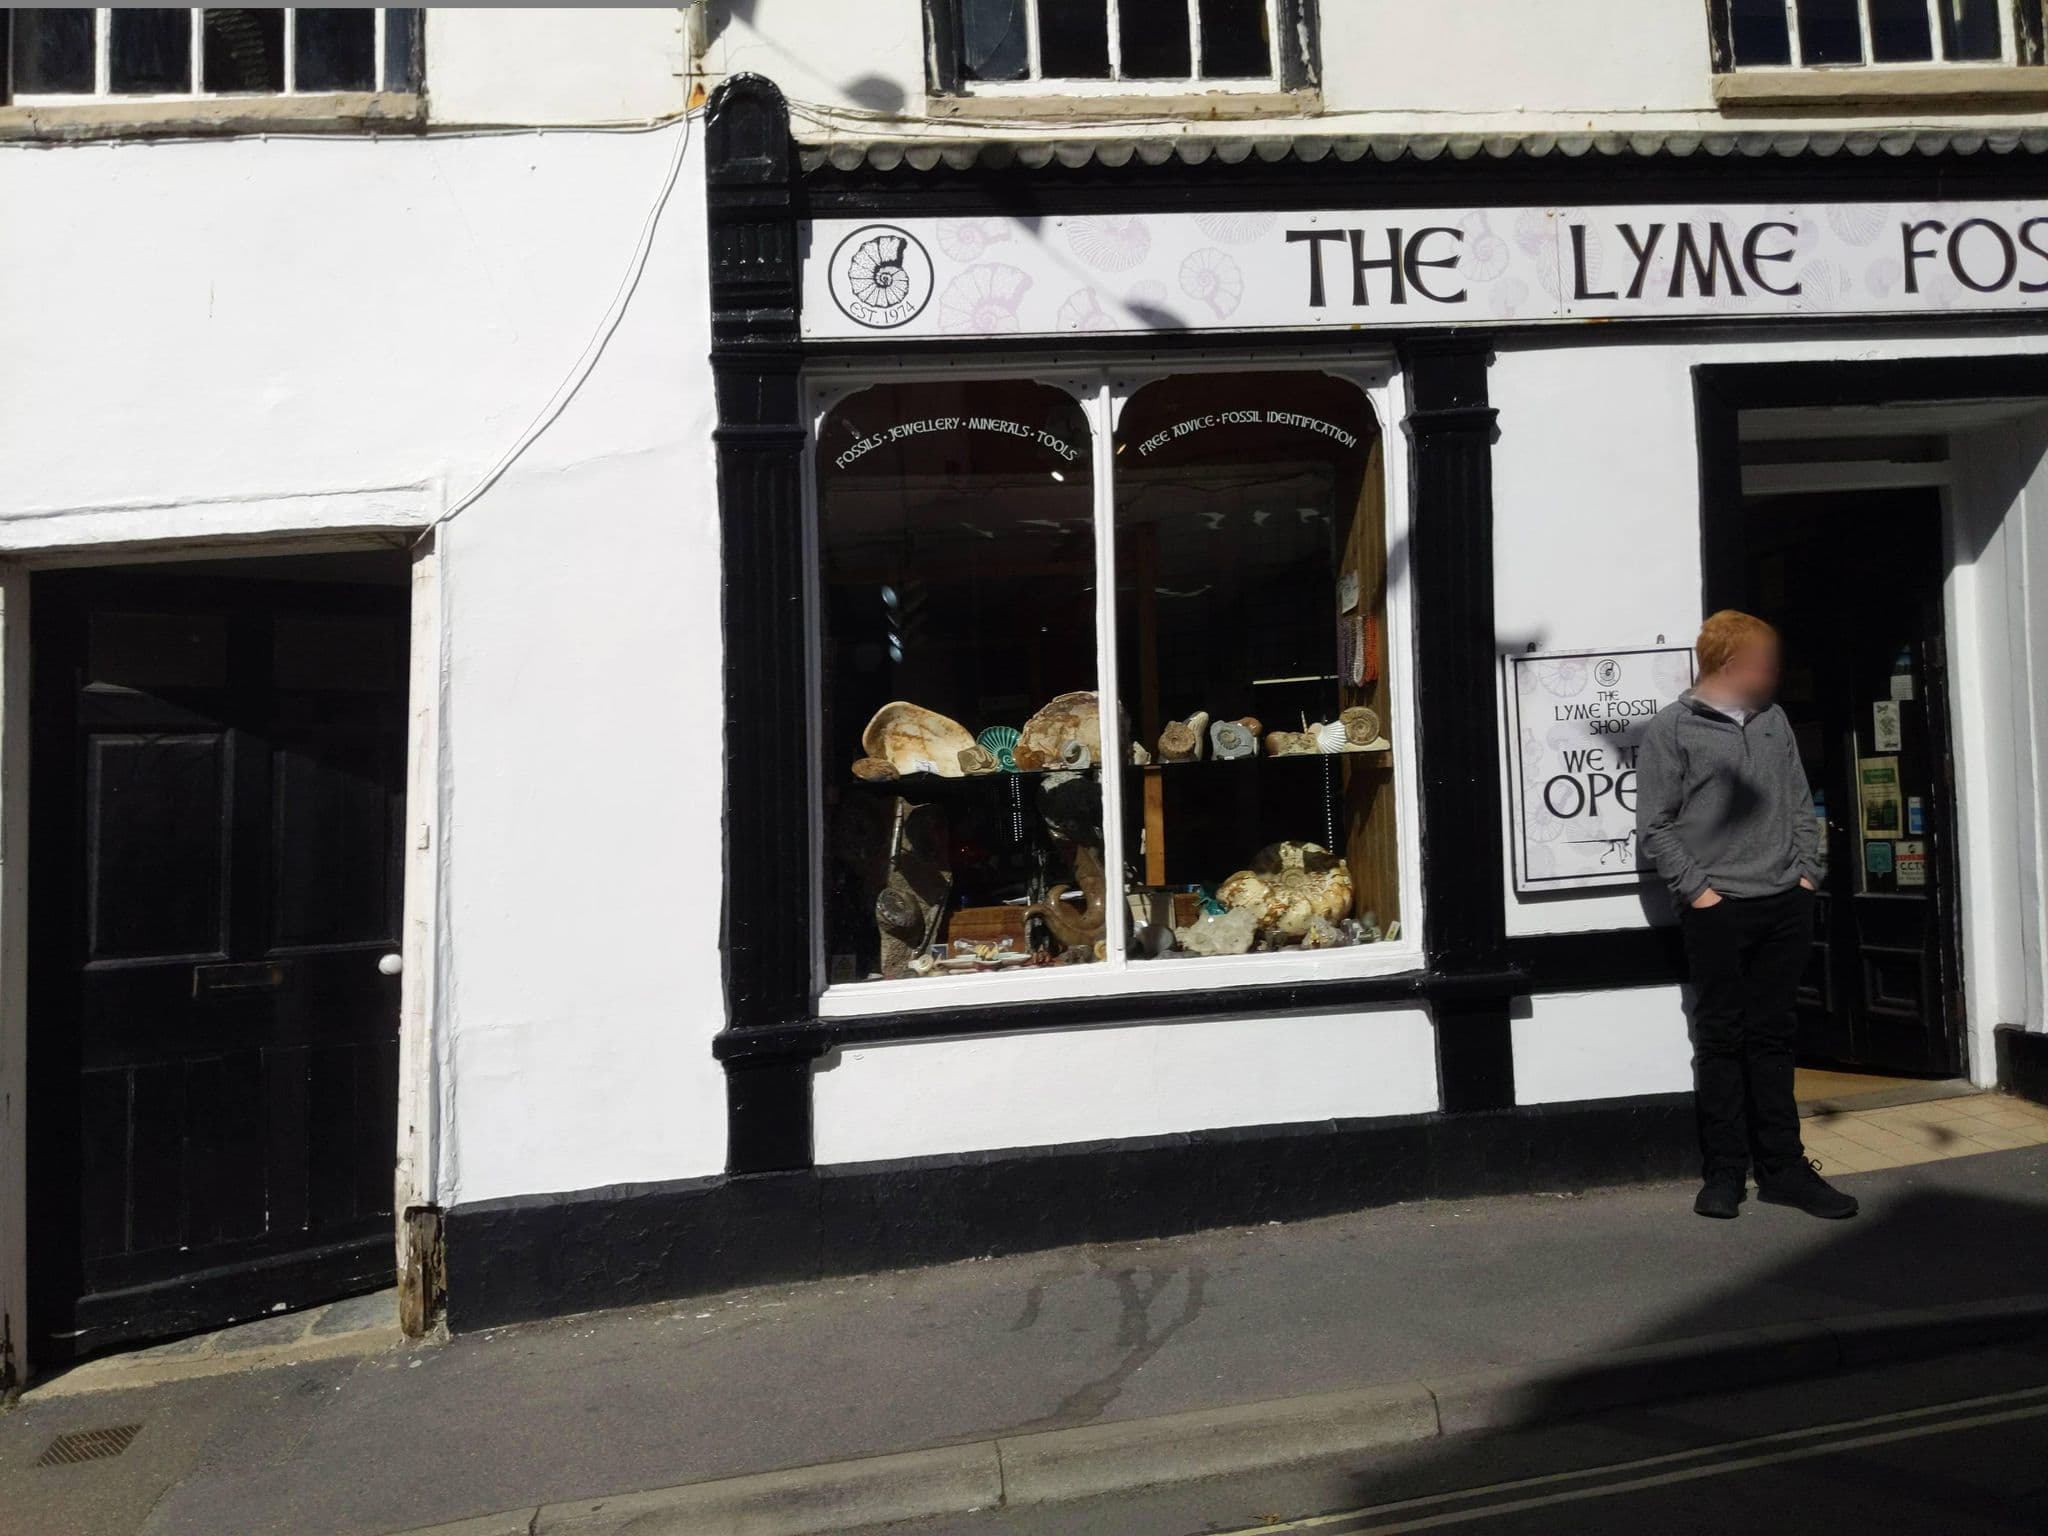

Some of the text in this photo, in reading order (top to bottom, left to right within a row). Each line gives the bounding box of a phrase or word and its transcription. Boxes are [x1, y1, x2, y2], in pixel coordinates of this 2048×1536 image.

[1285, 226, 1467, 308] THE
[1569, 221, 1802, 302] LYME
[849, 300, 916, 324] EST. 1974
[835, 417, 1078, 470] FOSSILS JEWELLERY MINERALS TOOLS
[1138, 410, 1358, 457] FREE ADVICE FOSSIL IDENTIFICATION
[1596, 690, 1620, 702] THE
[1554, 702, 1601, 721] LYME
[1589, 718, 1631, 736] SHOP
[1562, 748, 1605, 774] WE
[1543, 770, 1638, 819] OPE
